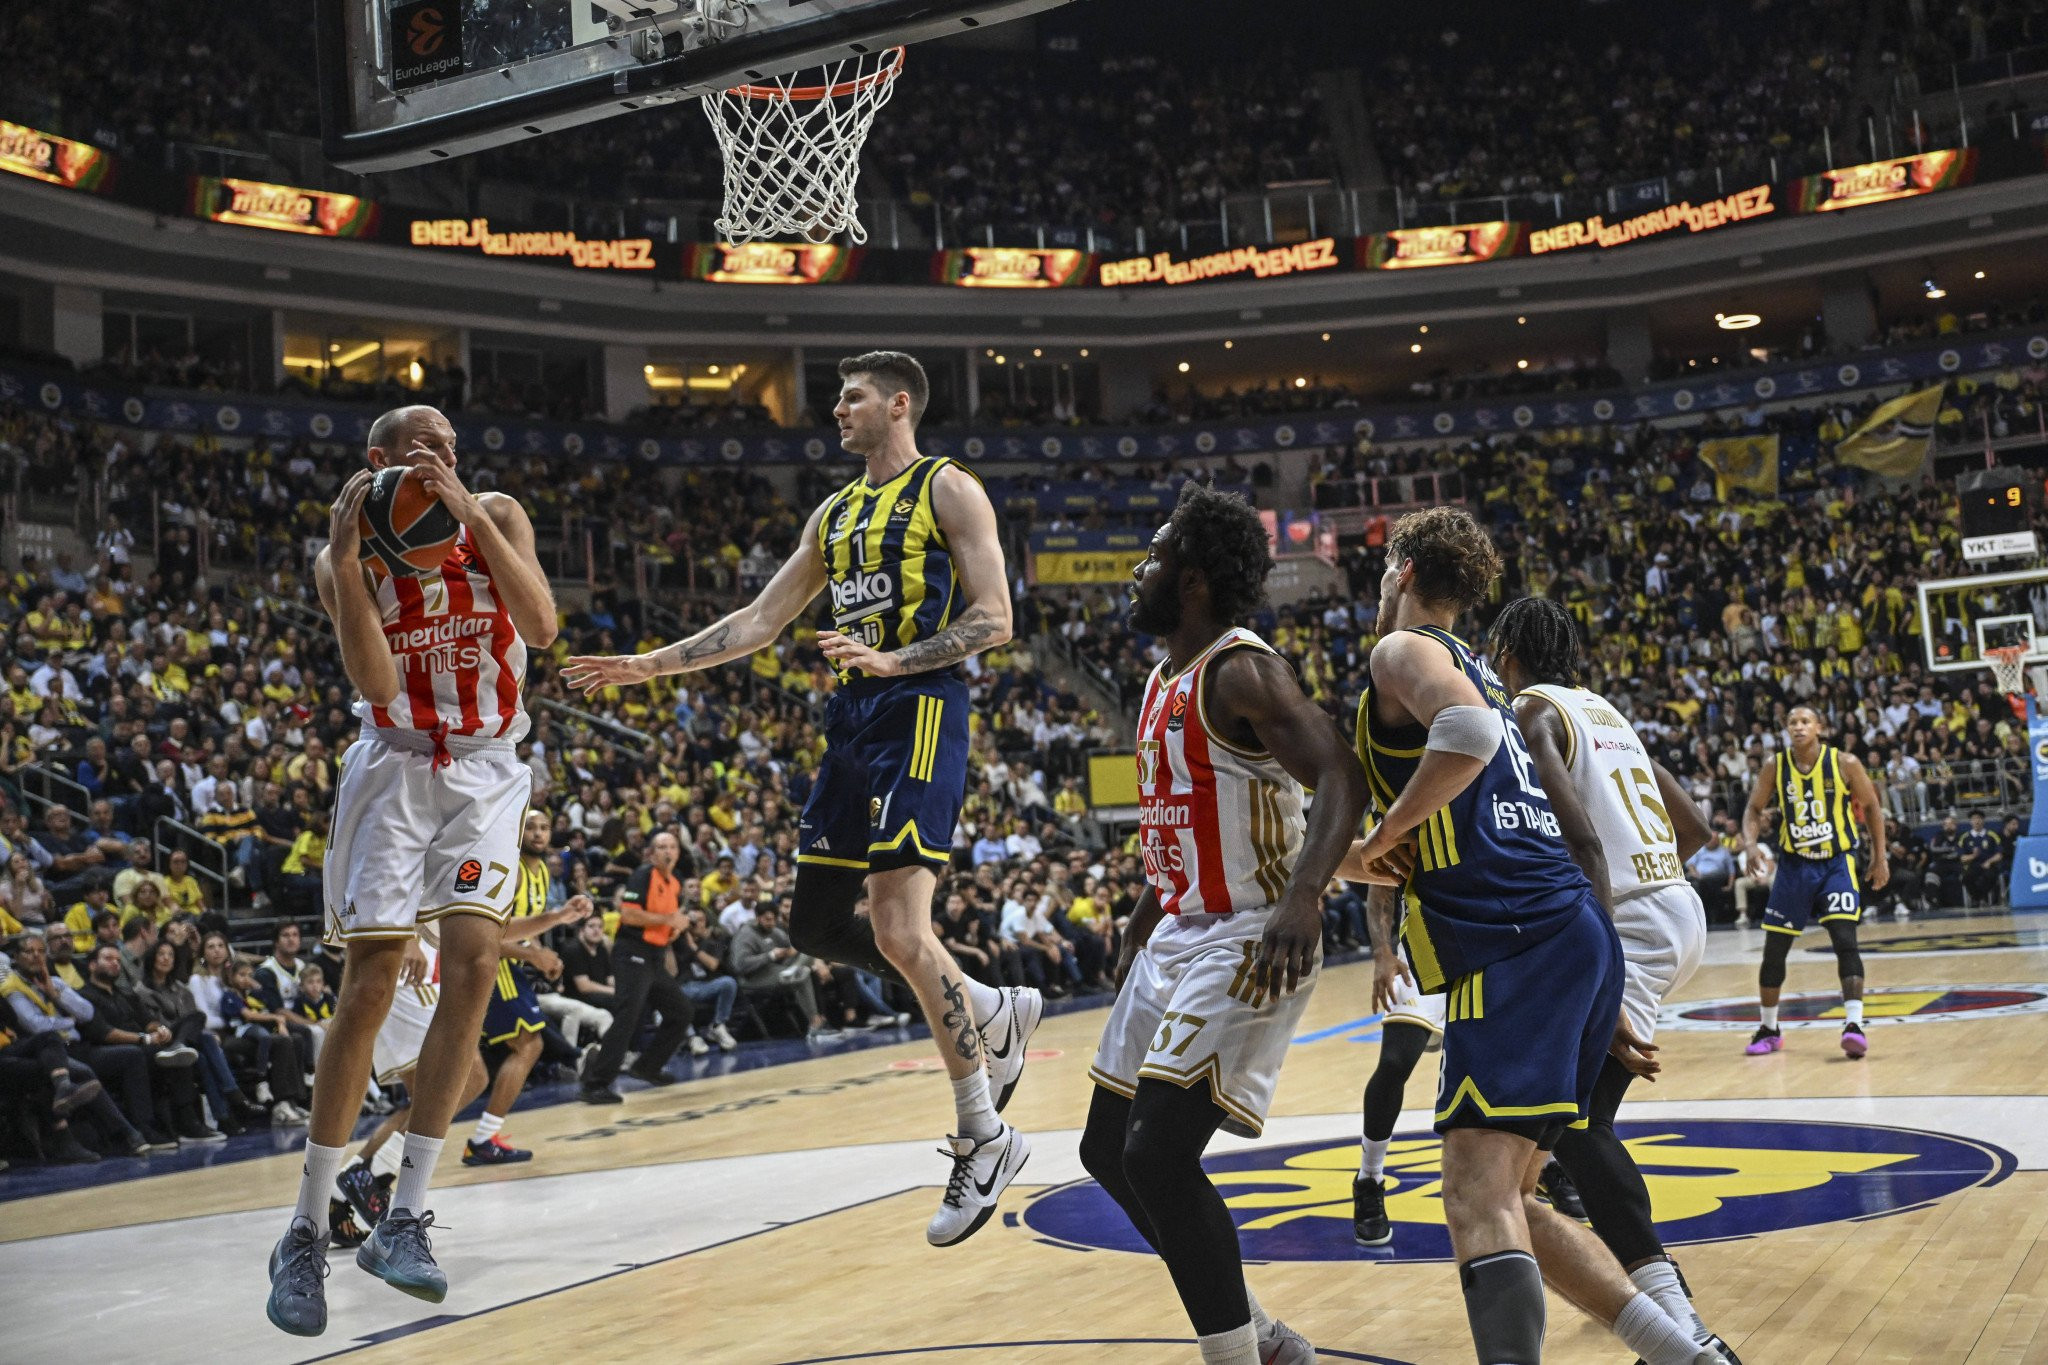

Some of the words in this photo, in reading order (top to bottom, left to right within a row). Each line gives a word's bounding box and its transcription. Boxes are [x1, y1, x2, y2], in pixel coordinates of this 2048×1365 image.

[395, 56, 460, 81] EuroLeague
[1832, 164, 1907, 200] metro
[233, 187, 312, 216] metro
[1687, 184, 1775, 232] DEMEZ
[572, 238, 656, 269] DEMEZ
[1253, 237, 1339, 278] DEMEZ
[2006, 486, 2021, 507] 9
[852, 532, 864, 566] 1
[1967, 540, 1995, 553] YKT
[419, 575, 444, 612] 7
[829, 570, 893, 611] beko
[388, 615, 492, 651] meridian
[403, 641, 480, 675] mts
[1137, 740, 1161, 785] 37
[879, 790, 894, 830] 1
[1140, 798, 1190, 826] eridian
[1609, 767, 1675, 845] 15
[1796, 800, 1824, 821] 20
[1789, 821, 1833, 839] beko
[485, 861, 510, 900] 7
[1827, 891, 1855, 912] 20
[1149, 1011, 1207, 1057] 37
